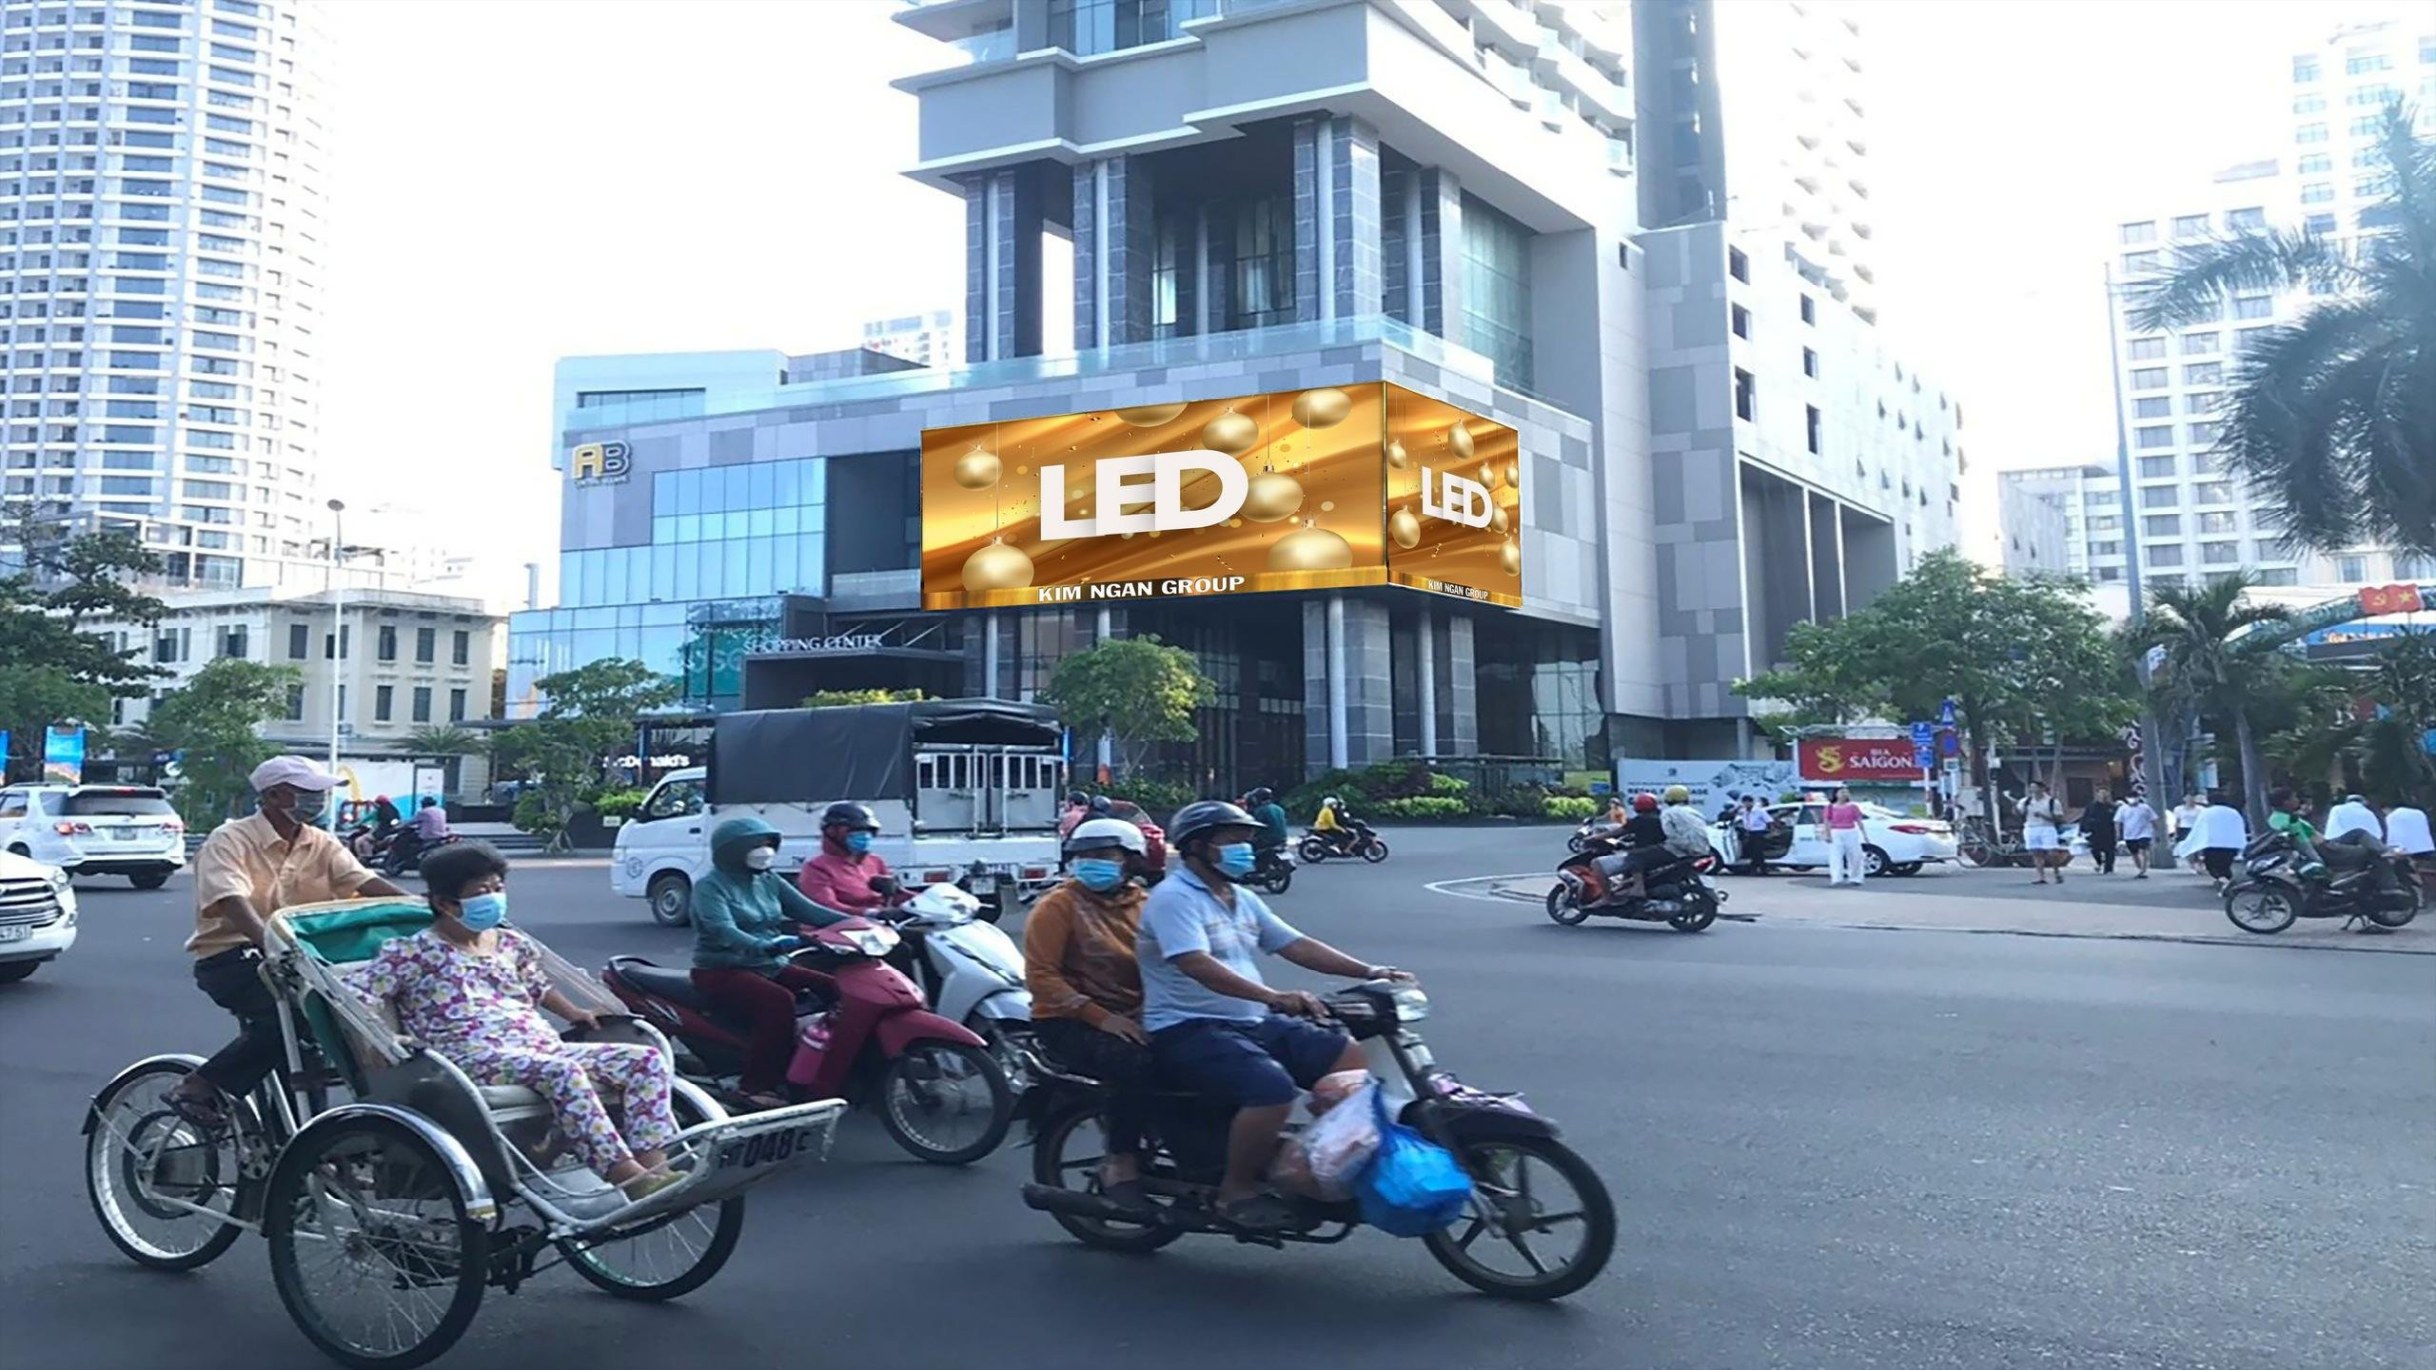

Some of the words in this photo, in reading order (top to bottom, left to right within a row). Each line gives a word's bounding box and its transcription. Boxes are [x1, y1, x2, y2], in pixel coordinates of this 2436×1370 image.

[572, 440, 632, 479] AB
[1039, 449, 1250, 542] LED
[1421, 465, 1494, 530] LED
[1037, 585, 1082, 602] KIM
[1090, 581, 1153, 600] NGAN
[1161, 575, 1246, 595] GROUP
[1427, 579, 1443, 592] KIM
[1444, 582, 1465, 596] NGAN
[1465, 587, 1489, 600] GROUP
[822, 633, 883, 650] CENTER
[1848, 756, 1913, 769] SAIGON
